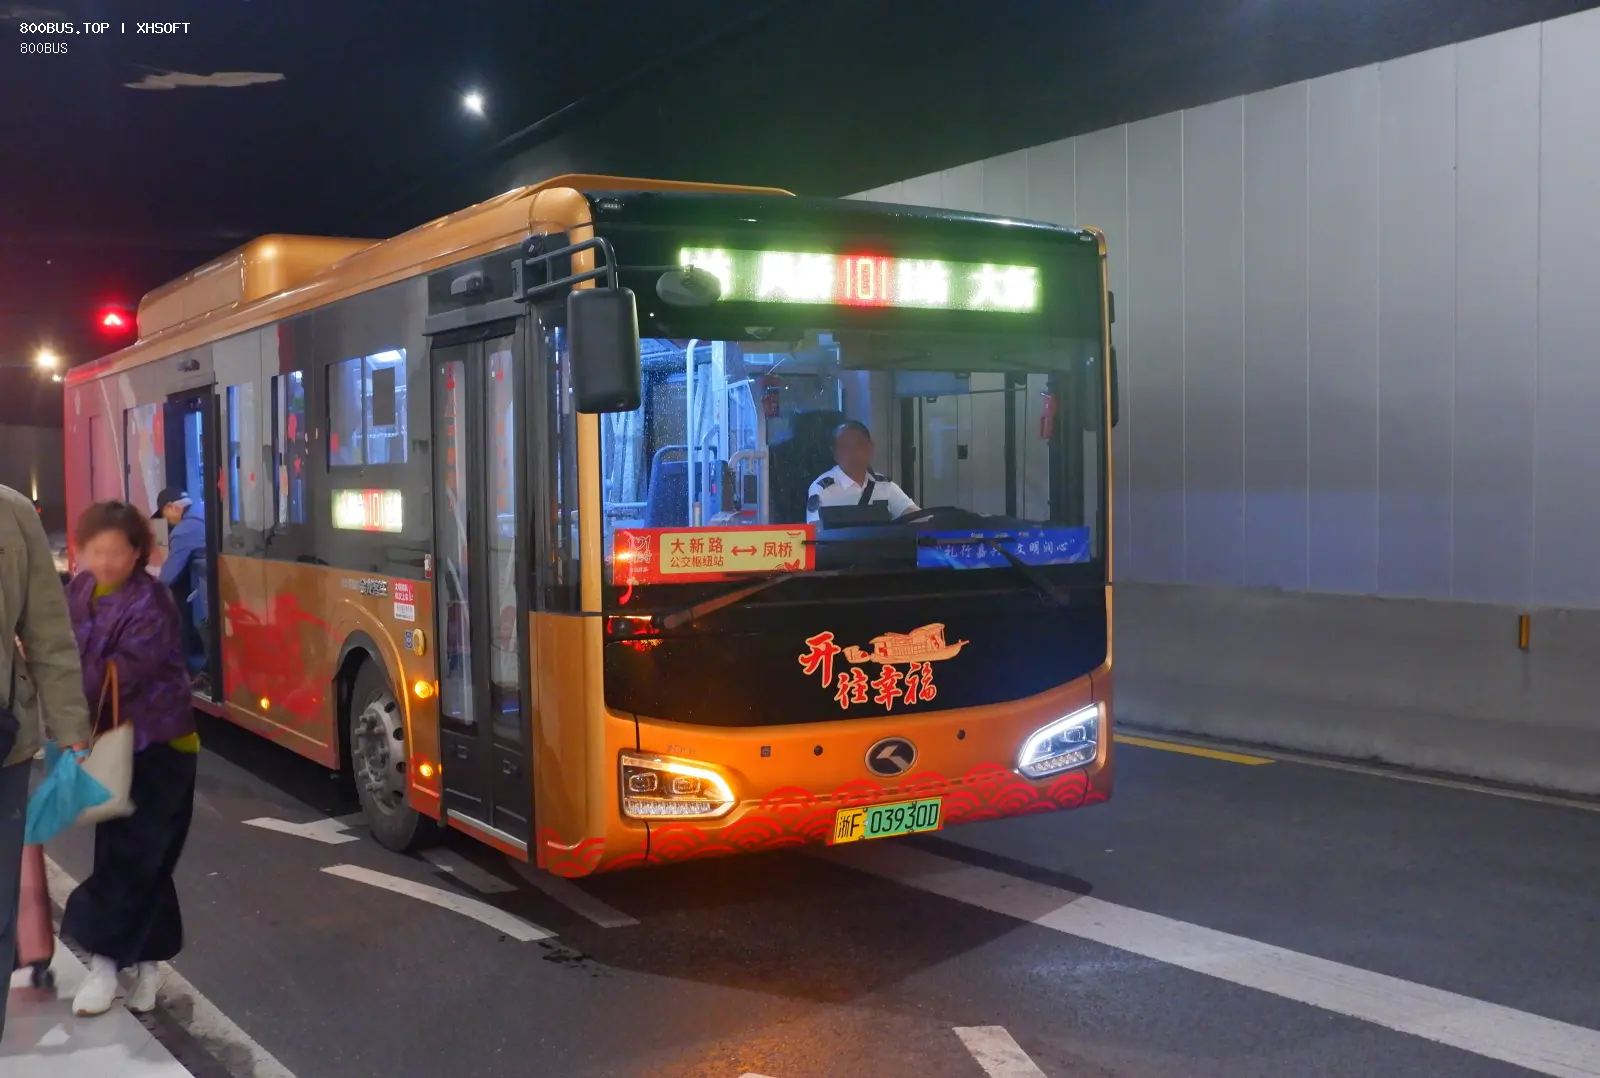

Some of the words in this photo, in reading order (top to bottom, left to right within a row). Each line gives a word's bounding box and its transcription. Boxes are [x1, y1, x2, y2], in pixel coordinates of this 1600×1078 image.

[844, 256, 888, 301] 101
[670, 537, 724, 555] 大新路
[762, 541, 793, 559] 凤桥
[669, 555, 724, 569] 公交枢纽站
